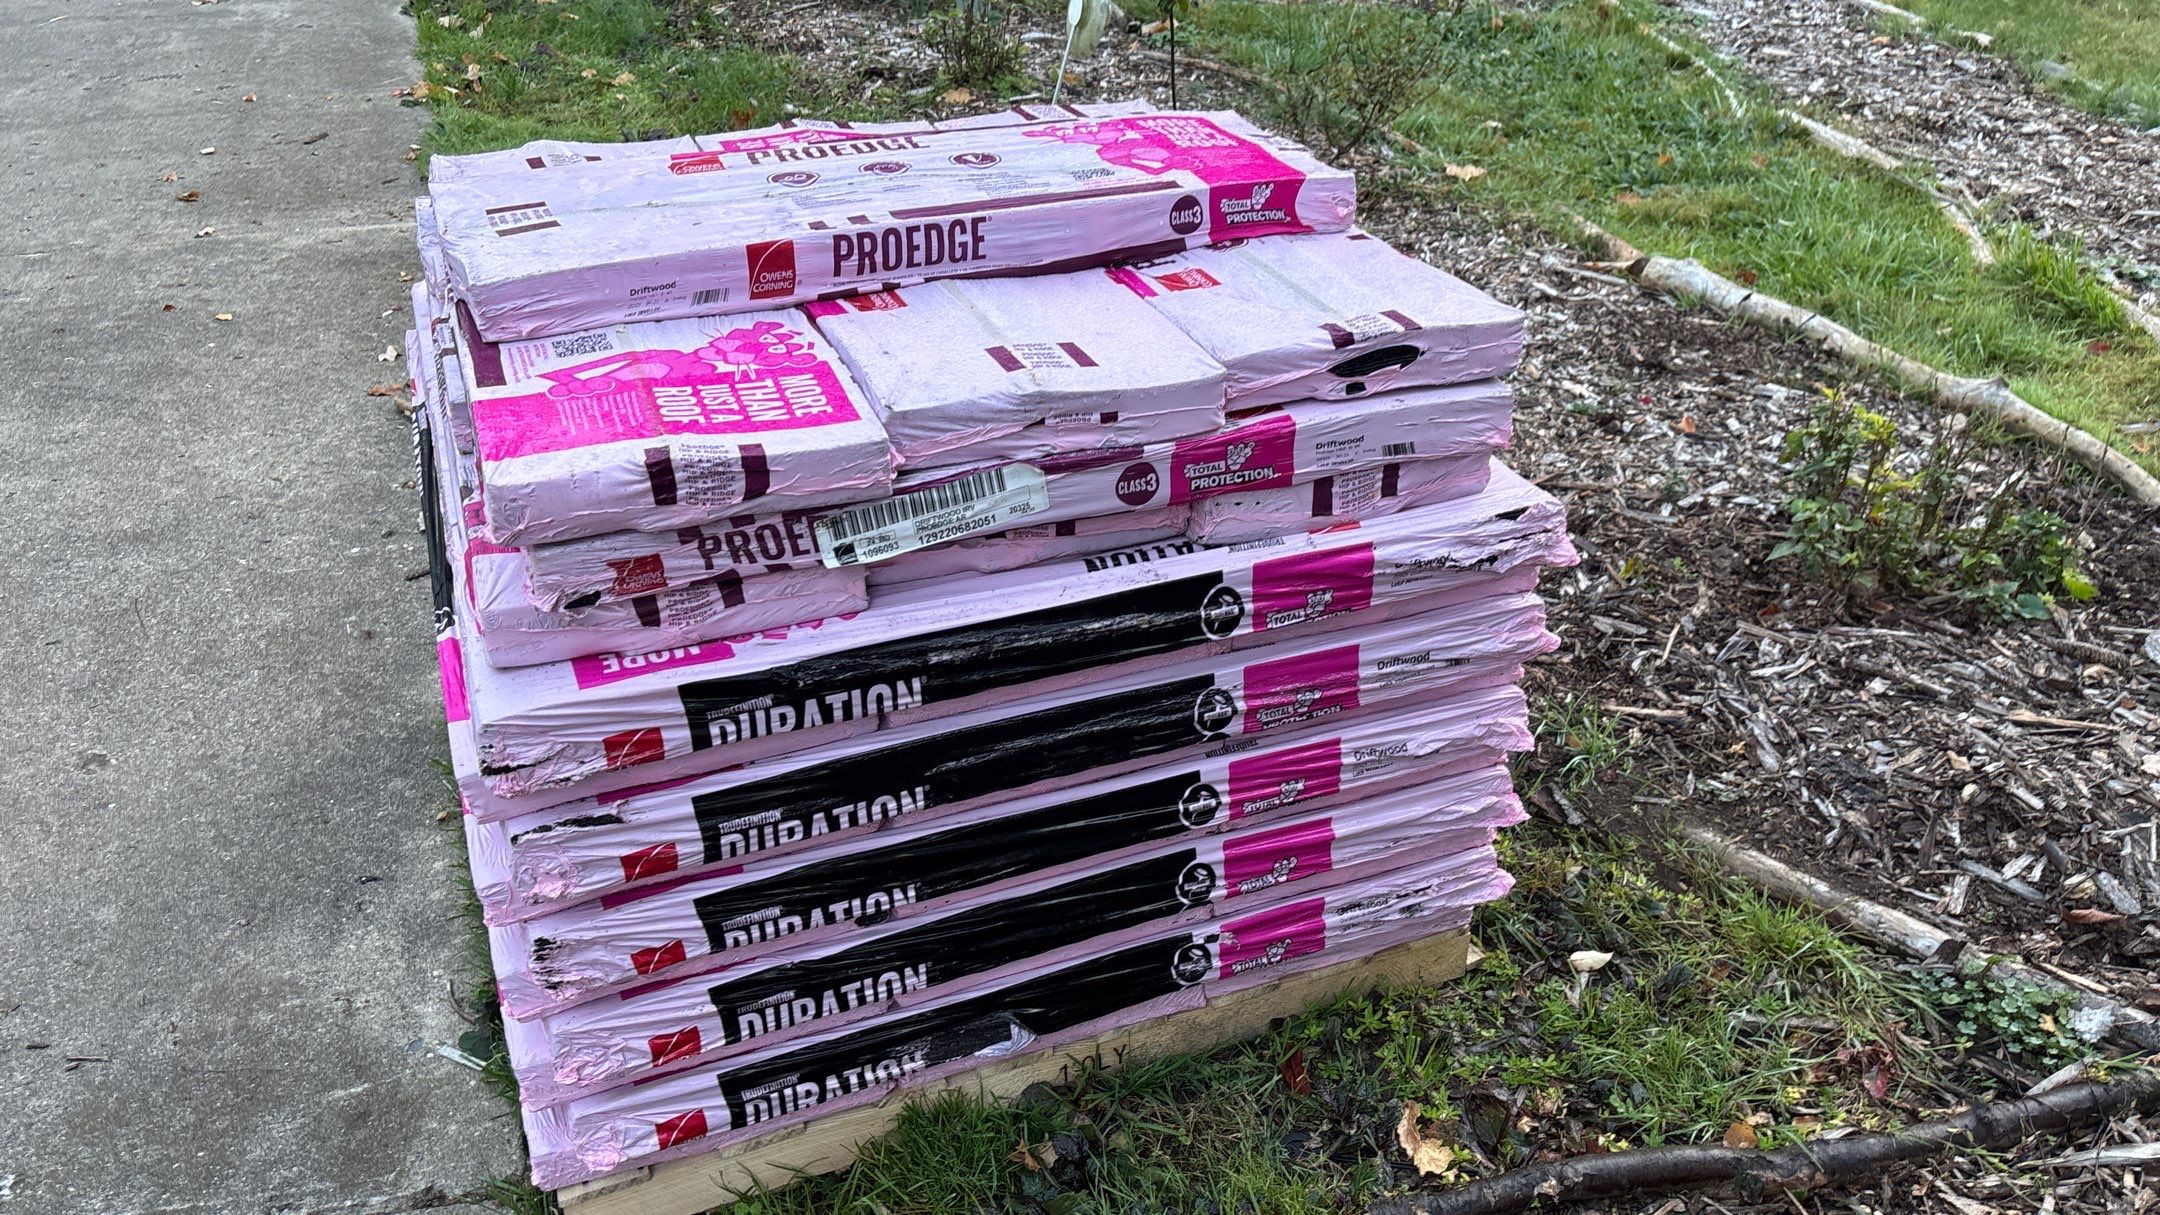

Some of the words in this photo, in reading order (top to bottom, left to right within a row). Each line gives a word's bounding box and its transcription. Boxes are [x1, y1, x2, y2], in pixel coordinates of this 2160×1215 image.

[1225, 200, 1250, 211] TOTAL
[1226, 209, 1287, 225] PROTECTION
[832, 216, 987, 277] PROEDGE
[760, 269, 794, 283] OWENS
[629, 280, 677, 297] Driftwood
[753, 280, 794, 293] CORNING
[696, 384, 741, 411] JUST
[735, 378, 791, 422] THAN
[779, 373, 834, 418] MORE
[652, 385, 706, 424] ROOF
[710, 413, 745, 424] A
[1315, 435, 1365, 450] Driftwood
[1191, 463, 1224, 476] TOTAL
[1190, 466, 1275, 491] PROTECTION
[1008, 501, 1031, 514] 20325
[914, 508, 962, 528] DRIFTWOOD
[918, 513, 997, 545] 129220682051
[1273, 611, 1305, 626] TOTAL
[1377, 651, 1431, 670] Driftwood
